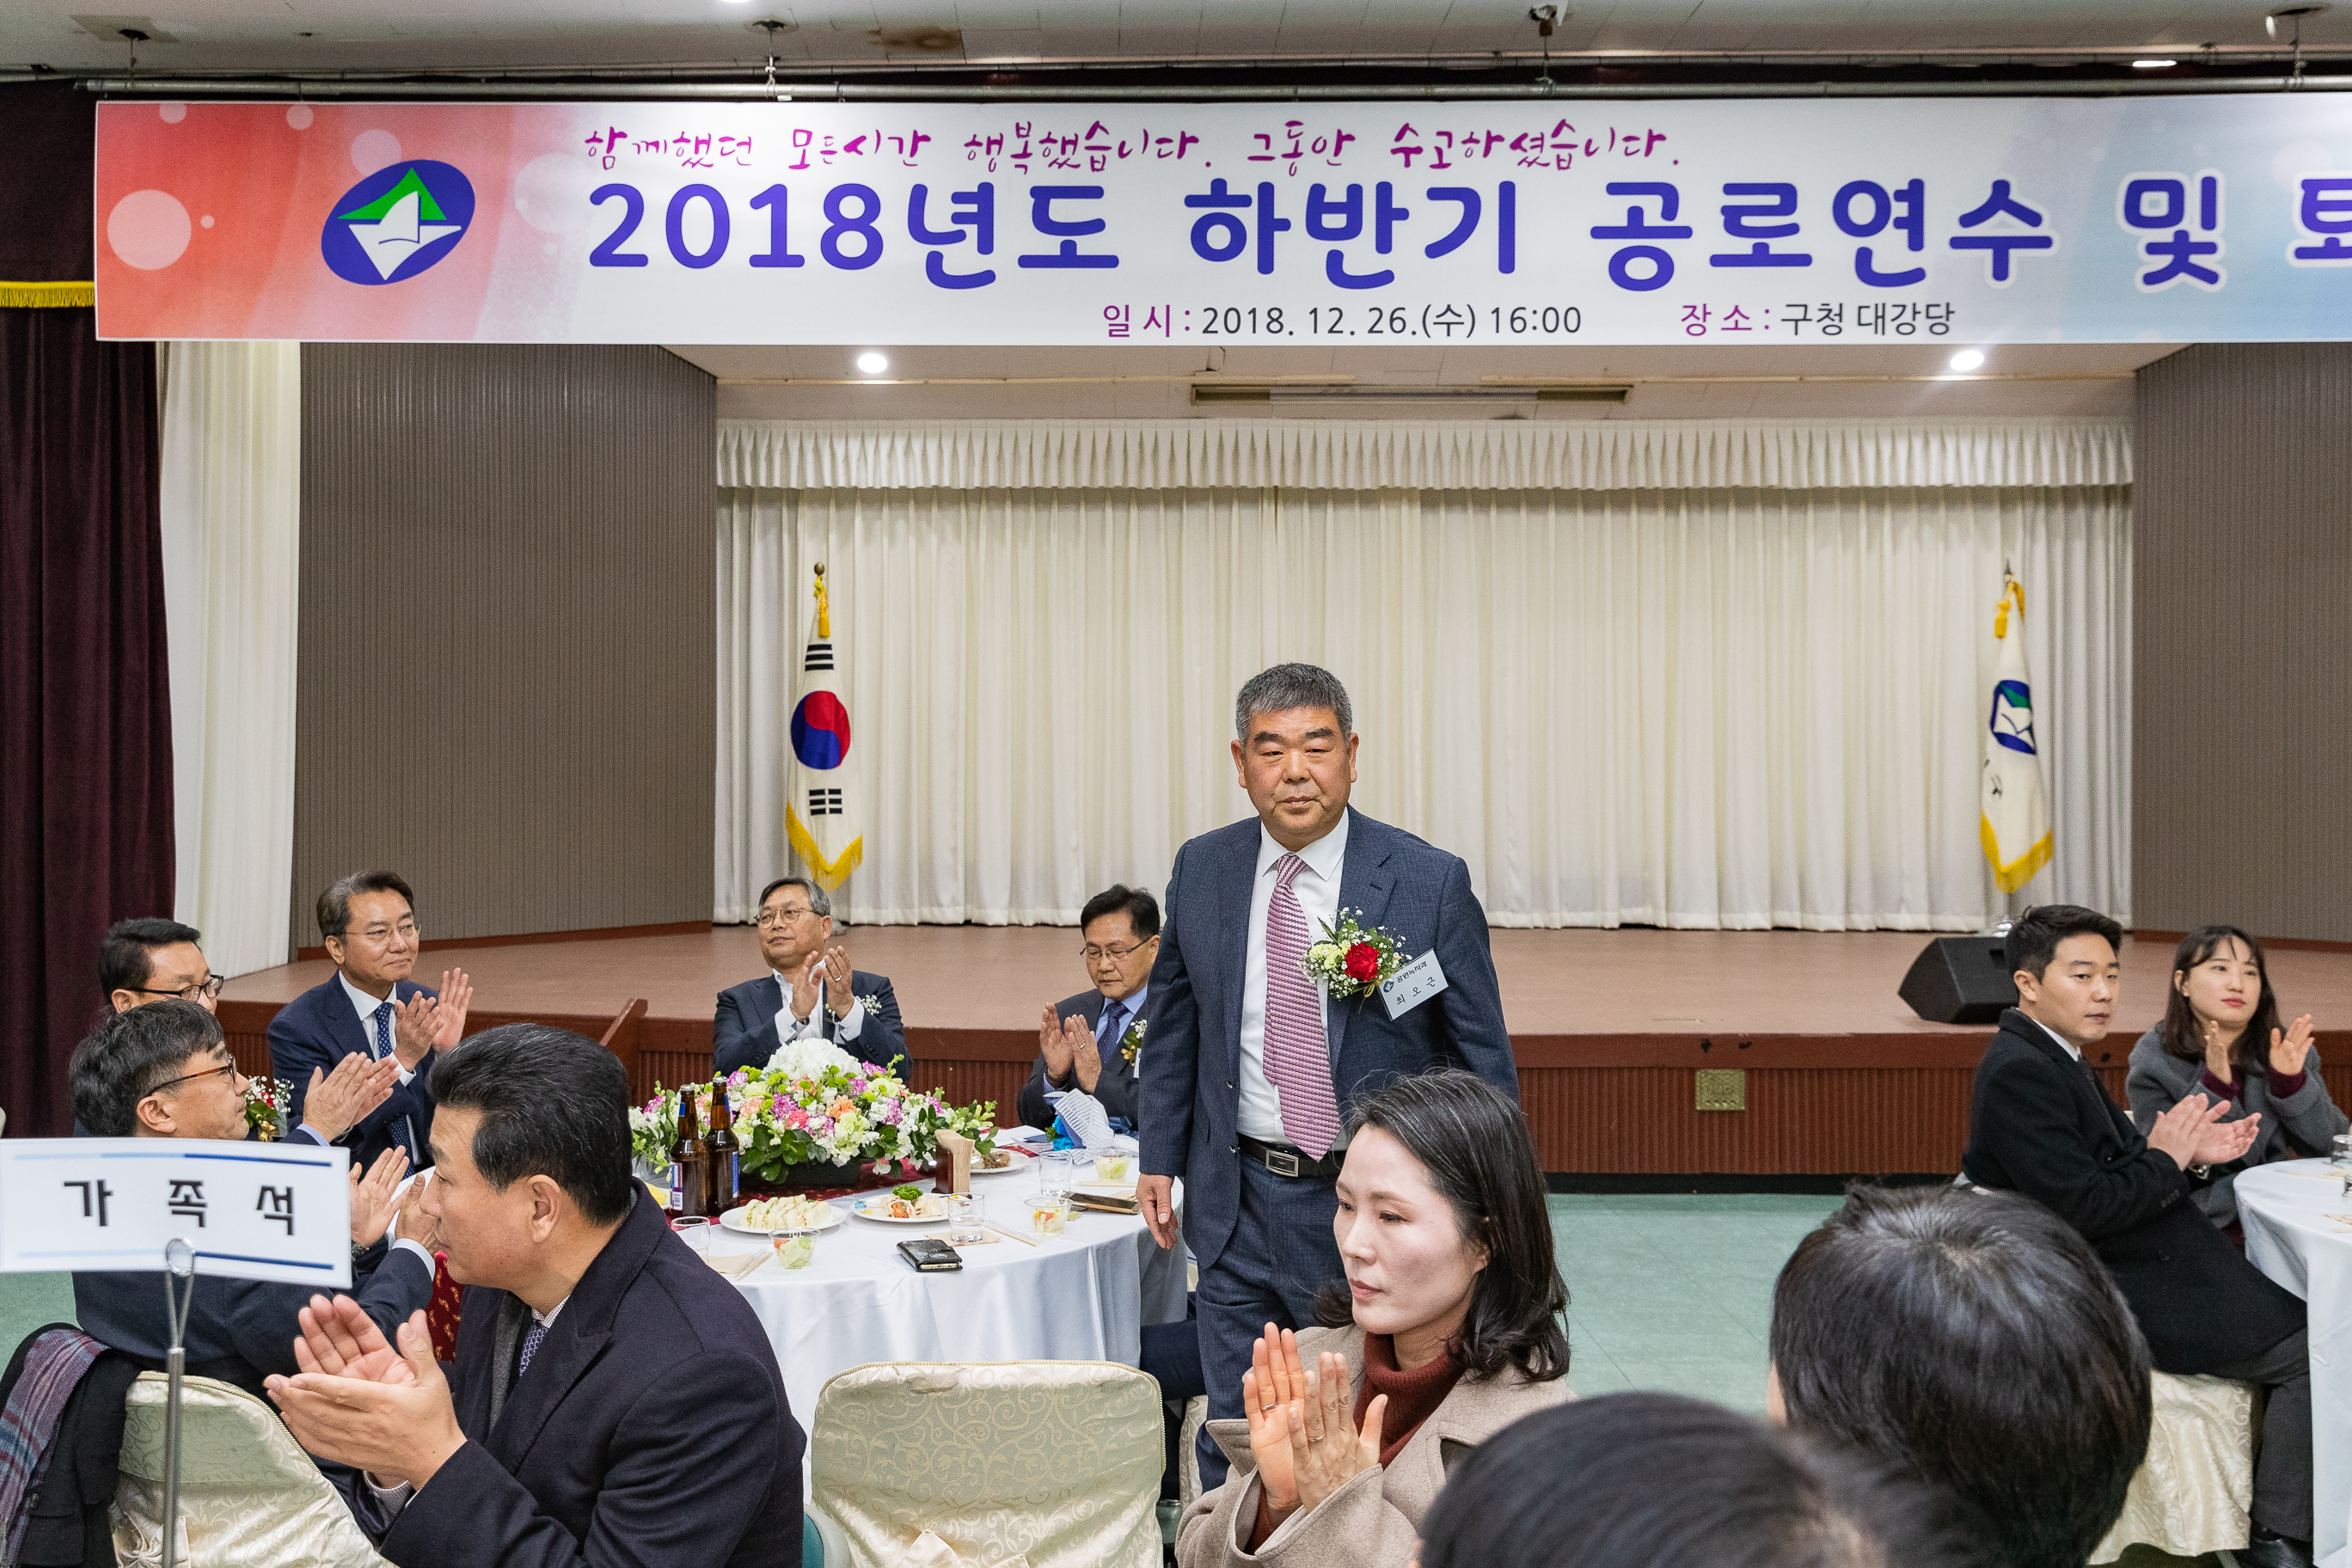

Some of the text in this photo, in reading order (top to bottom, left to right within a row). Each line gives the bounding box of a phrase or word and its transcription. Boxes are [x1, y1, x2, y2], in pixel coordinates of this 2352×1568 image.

[584, 119, 1679, 175] 함께했던 모든시간 행복했습니다. 그동안 수고하셨습니다.
[589, 181, 1119, 290] 2018년도
[1184, 178, 1516, 290] 하반기
[1589, 179, 2053, 291] 공로연수
[2124, 176, 2219, 285] 및
[1491, 306, 1581, 334] 16:00
[1781, 303, 1843, 337] 구청
[1857, 302, 1956, 336] 대강당
